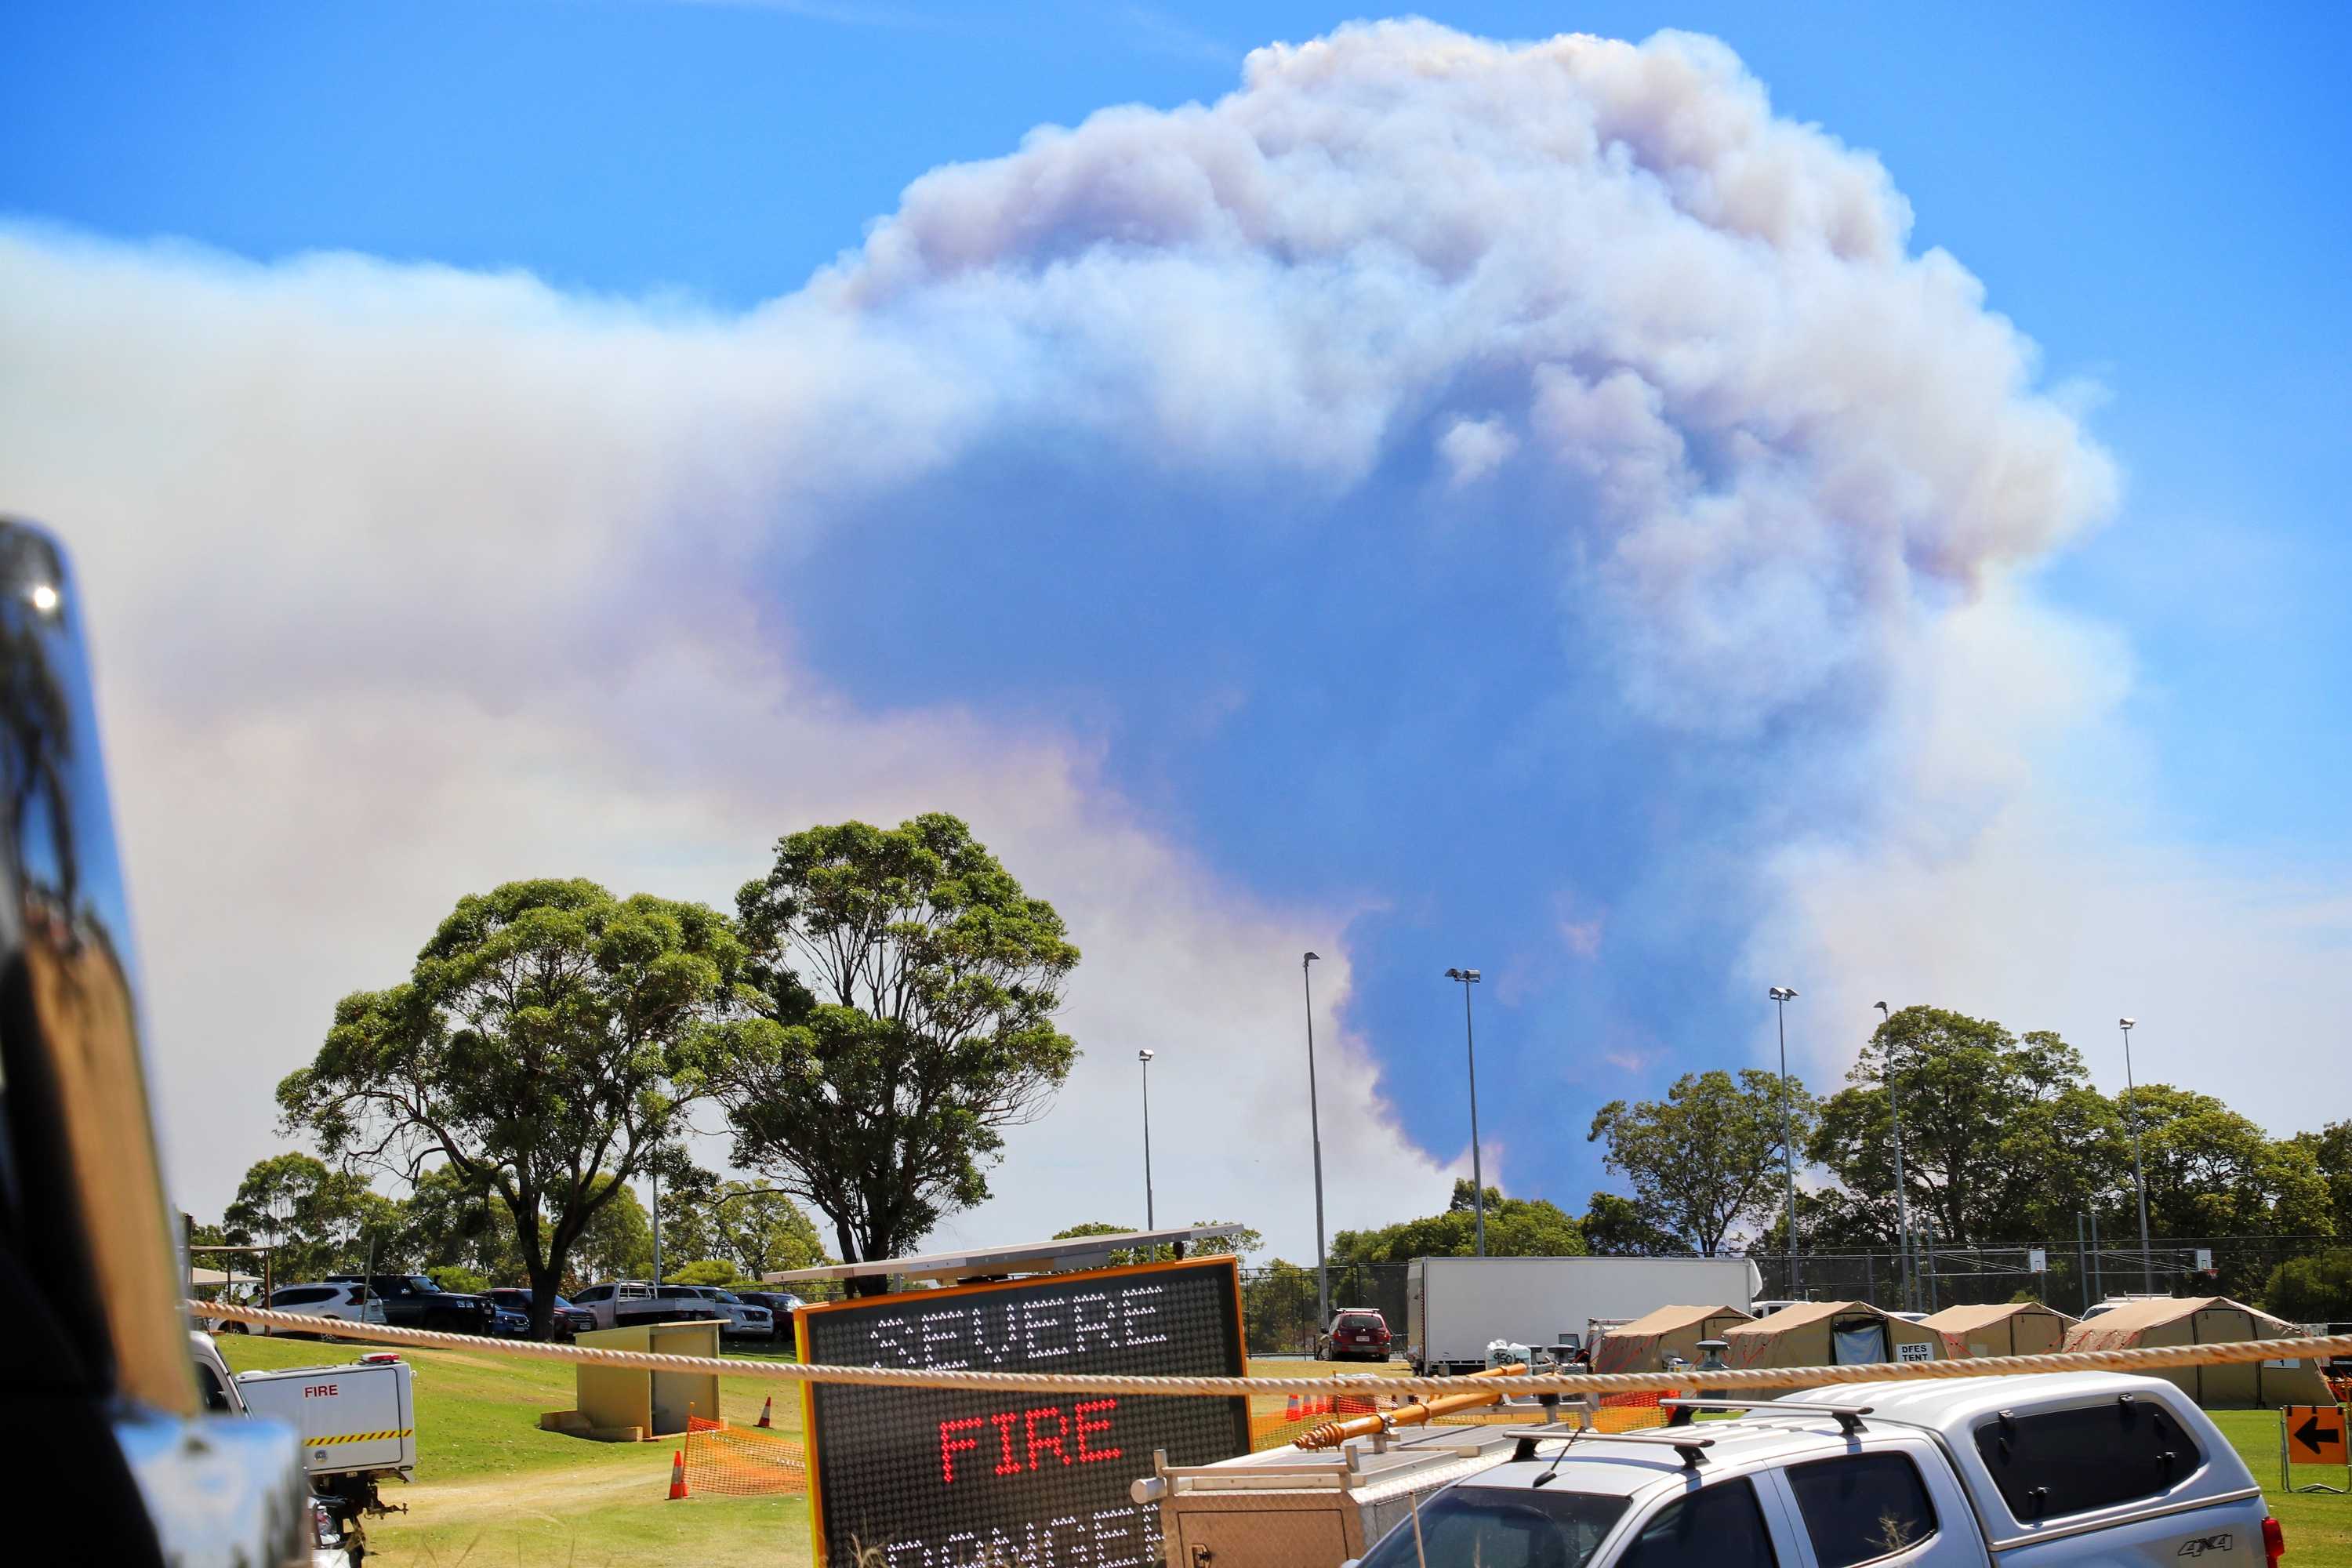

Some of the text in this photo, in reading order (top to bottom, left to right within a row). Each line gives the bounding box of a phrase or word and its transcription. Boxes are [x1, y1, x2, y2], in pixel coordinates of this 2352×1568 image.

[870, 1286, 1167, 1372] SEVERE
[1902, 1345, 1927, 1353] DFES
[304, 1385, 338, 1398] FIRE
[938, 1398, 1123, 1484] FIRE
